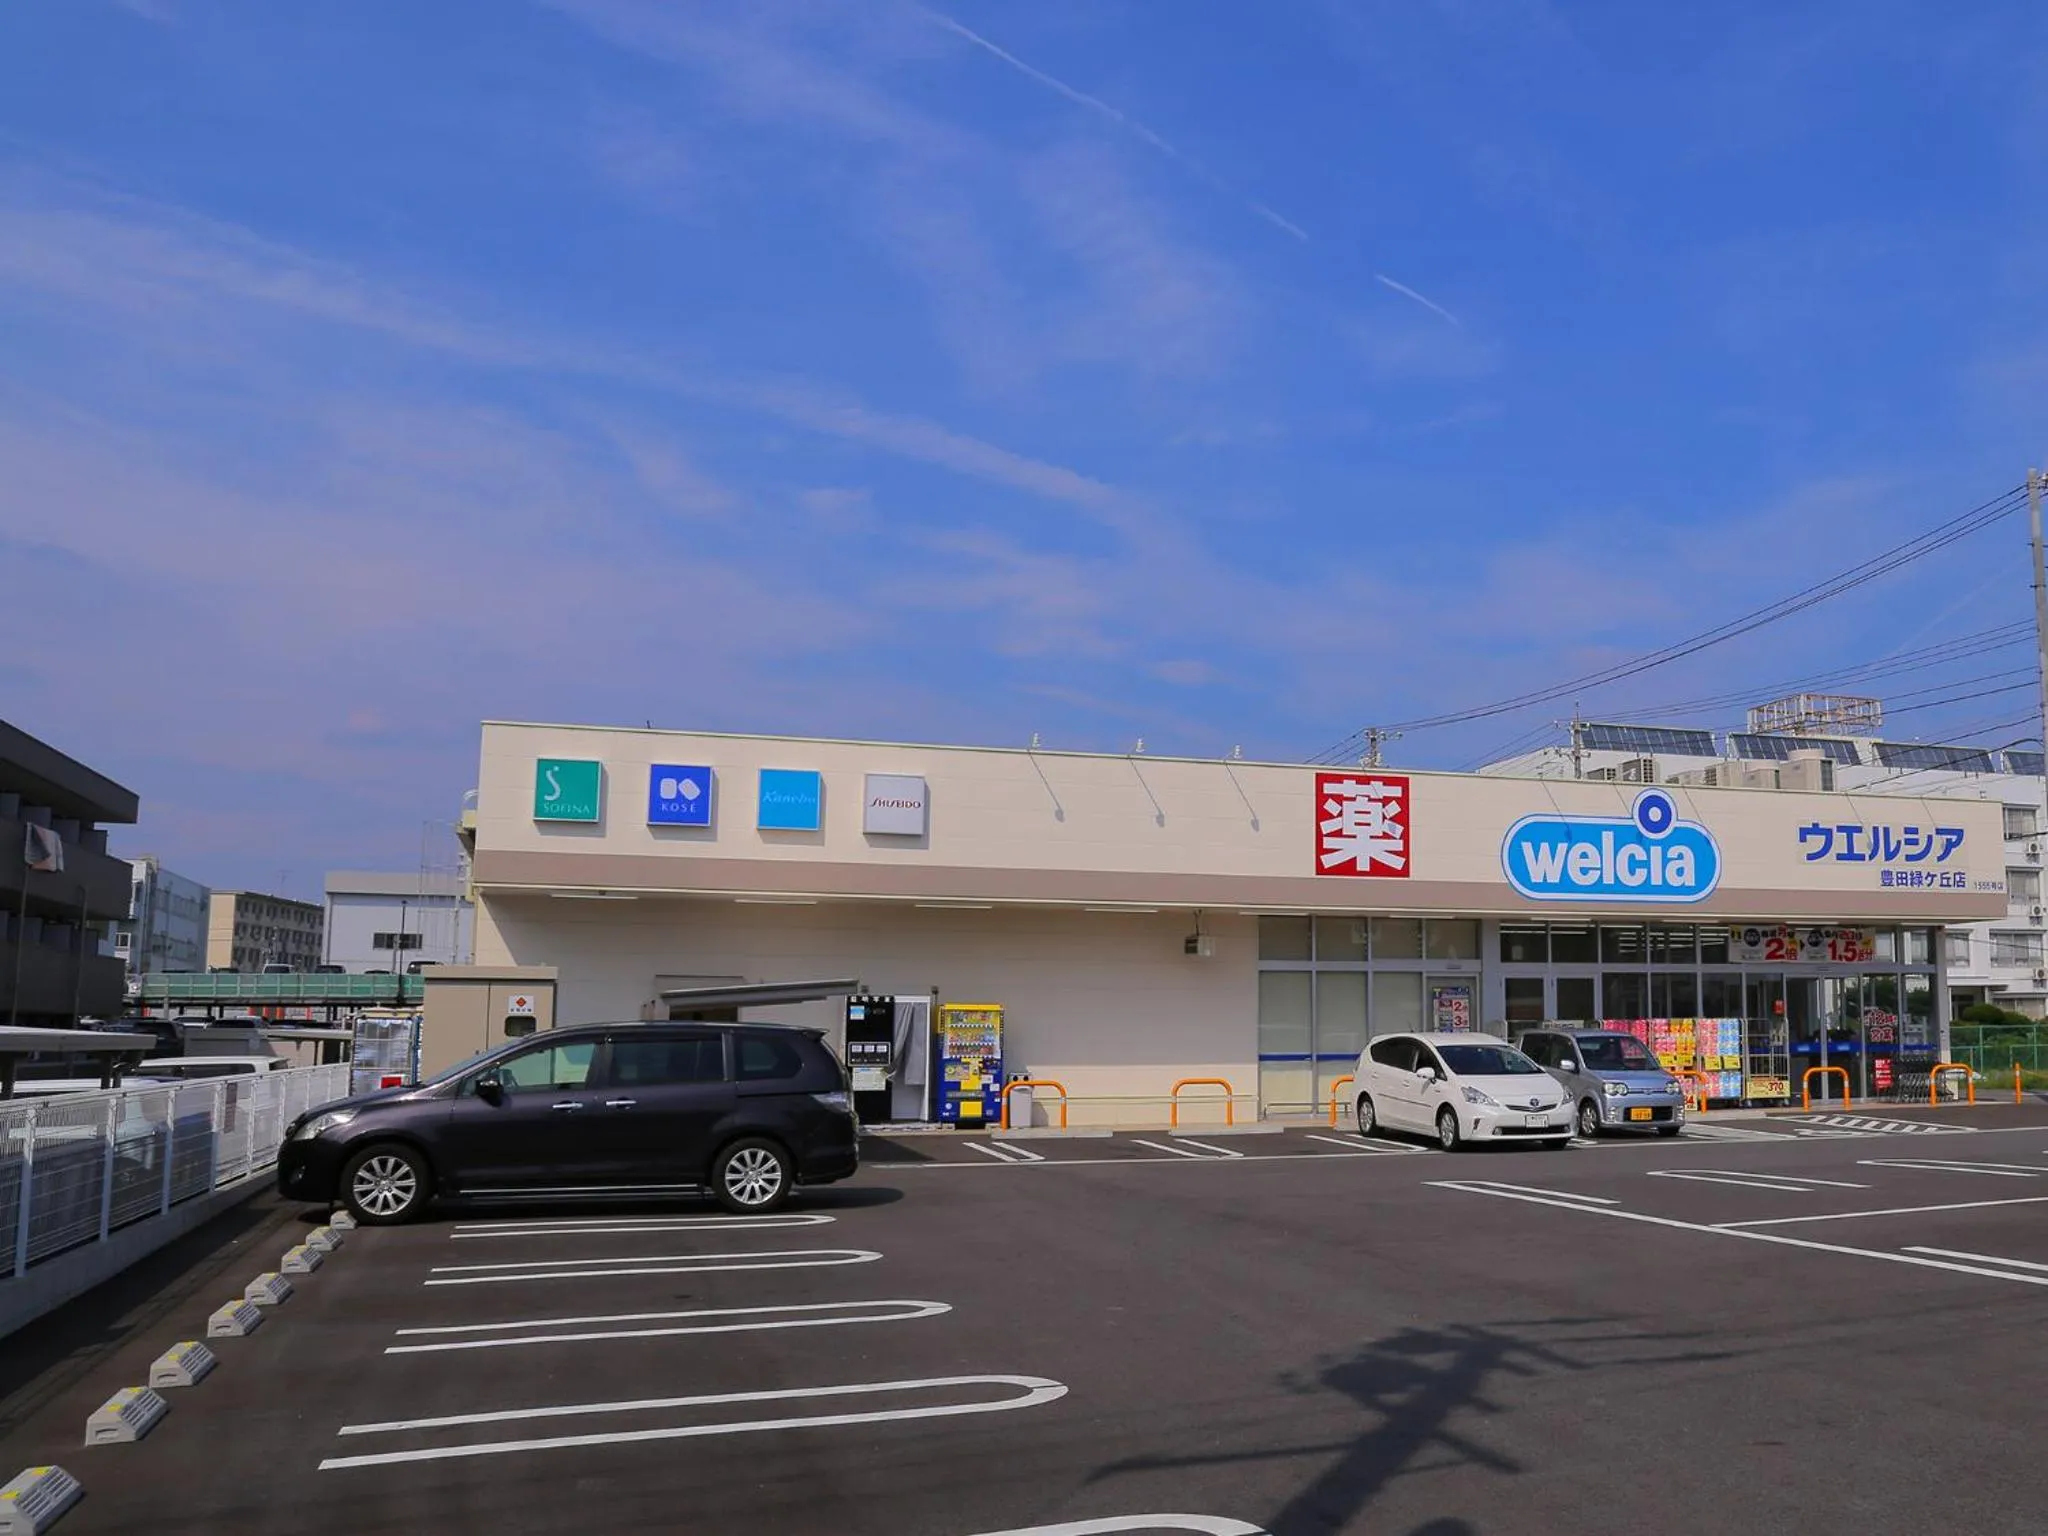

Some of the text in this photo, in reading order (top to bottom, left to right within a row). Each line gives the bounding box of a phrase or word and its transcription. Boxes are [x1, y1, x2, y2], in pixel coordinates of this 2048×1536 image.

[543, 801, 590, 815] SOFINA
[869, 797, 922, 809] SHISEIDO
[1319, 779, 1407, 872] 薬
[1521, 795, 1697, 888] welcia
[1799, 821, 1965, 863] ウエルシア
